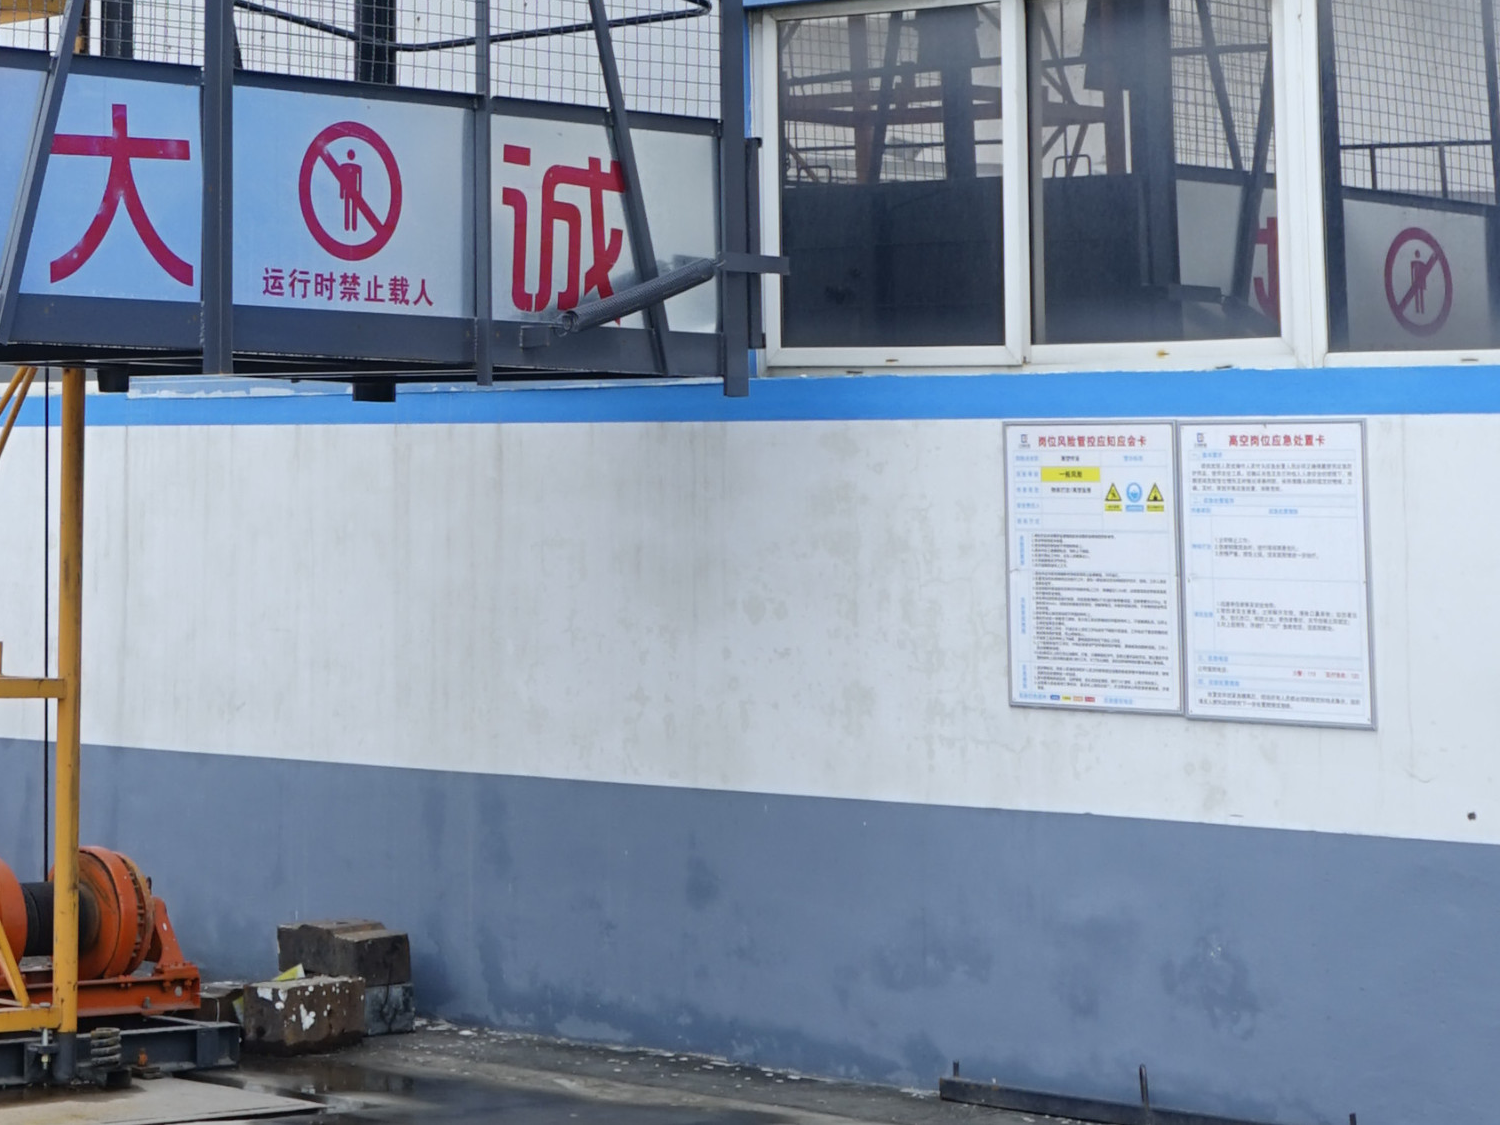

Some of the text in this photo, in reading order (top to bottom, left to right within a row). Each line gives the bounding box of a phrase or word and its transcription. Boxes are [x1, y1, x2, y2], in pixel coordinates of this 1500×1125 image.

[50, 102, 625, 326] 大 诚
[261, 266, 435, 308] 运行时禁止载人
[1228, 433, 1326, 447] 高空岗位应急处置卡
